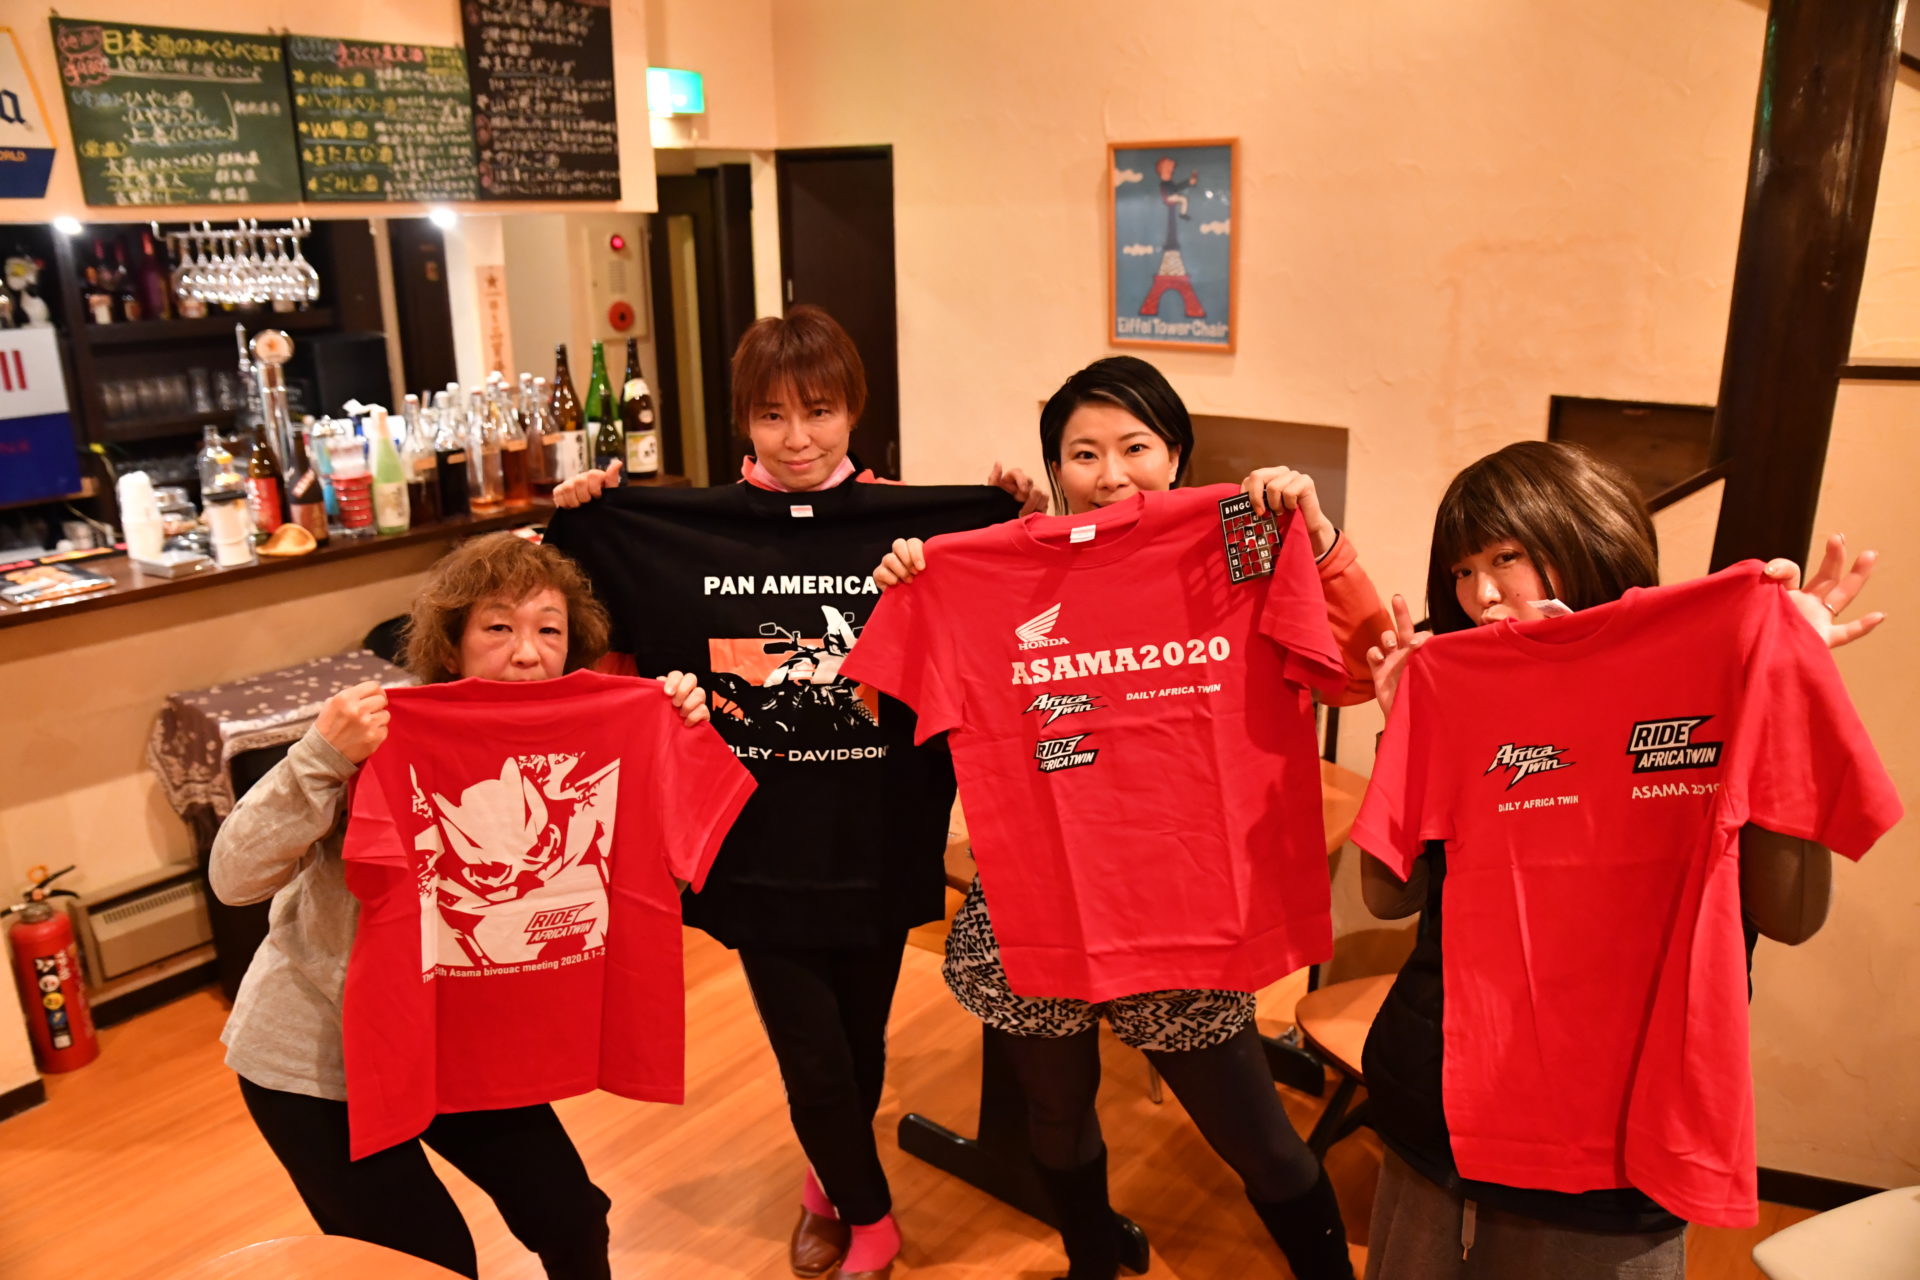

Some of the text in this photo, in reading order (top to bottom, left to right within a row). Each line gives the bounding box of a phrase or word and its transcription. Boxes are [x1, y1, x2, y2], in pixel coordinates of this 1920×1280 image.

[1118, 317, 1229, 338] Eiffel Tower Chair
[704, 574, 879, 596] PAN AMERICA
[1018, 636, 1070, 651] HONDA
[1010, 636, 1231, 686] ASAMA2020
[1126, 683, 1221, 701] DAILY AFRICA TWIN
[1024, 693, 1100, 715] Africa
[1042, 703, 1106, 727] Twin
[1633, 722, 1690, 748] RIDE
[1038, 738, 1076, 758] RIDE
[1485, 743, 1569, 776] Africa
[1506, 757, 1575, 790] Twin
[1523, 797, 1555, 809] AFRICA
[1557, 795, 1579, 806] TWIN
[1632, 782, 1690, 800] ASAMA
[532, 909, 576, 928] RIDE
[422, 971, 436, 984] The
[449, 967, 482, 977] Asama
[483, 965, 520, 977] bivouac
[522, 959, 559, 973] meeting
